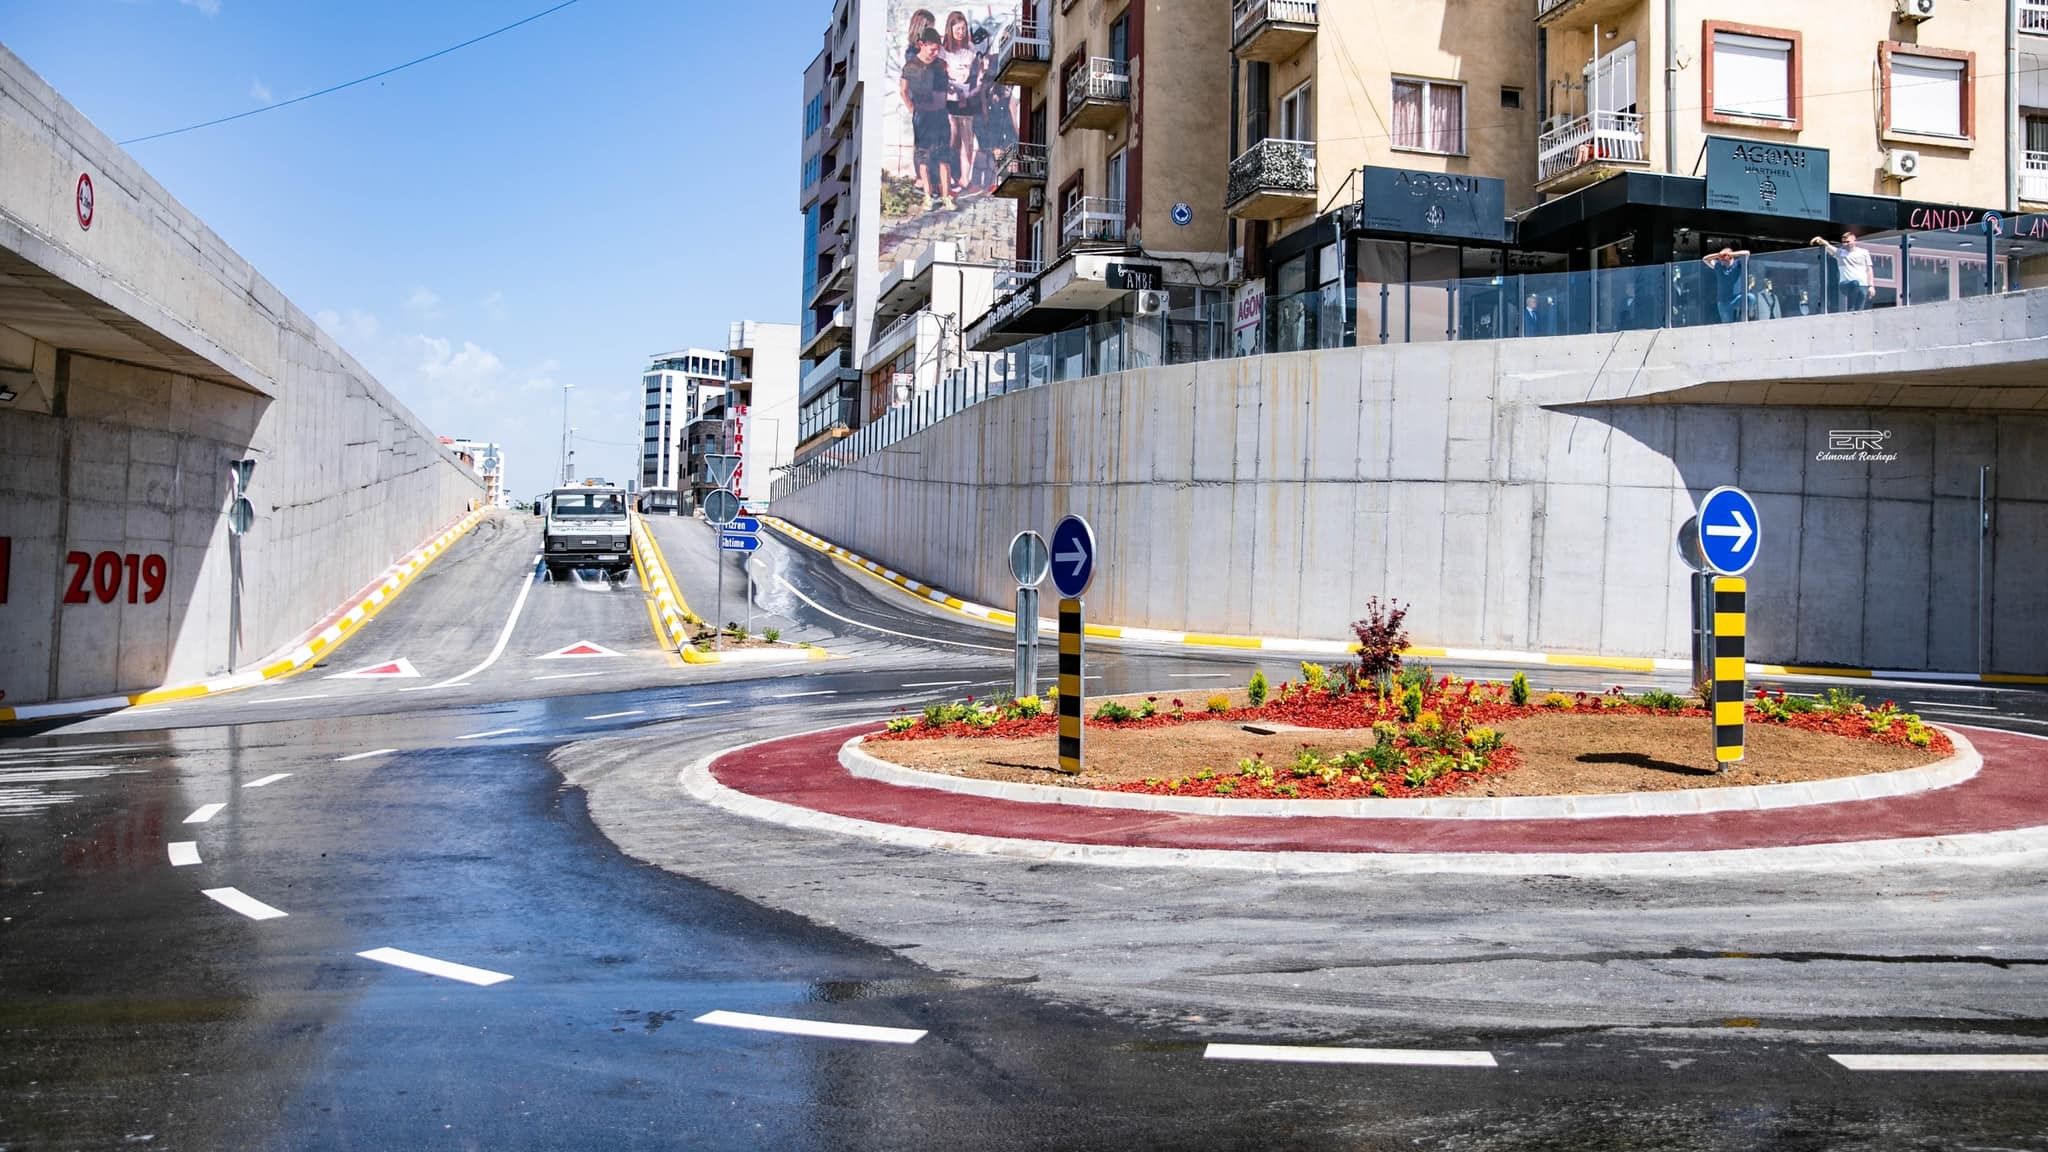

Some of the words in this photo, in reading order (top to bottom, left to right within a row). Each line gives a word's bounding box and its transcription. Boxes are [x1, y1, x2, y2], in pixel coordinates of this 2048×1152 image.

[1731, 144, 1805, 168] AGONI
[1910, 208, 1974, 233] CANDY
[63, 550, 167, 604] 2019
